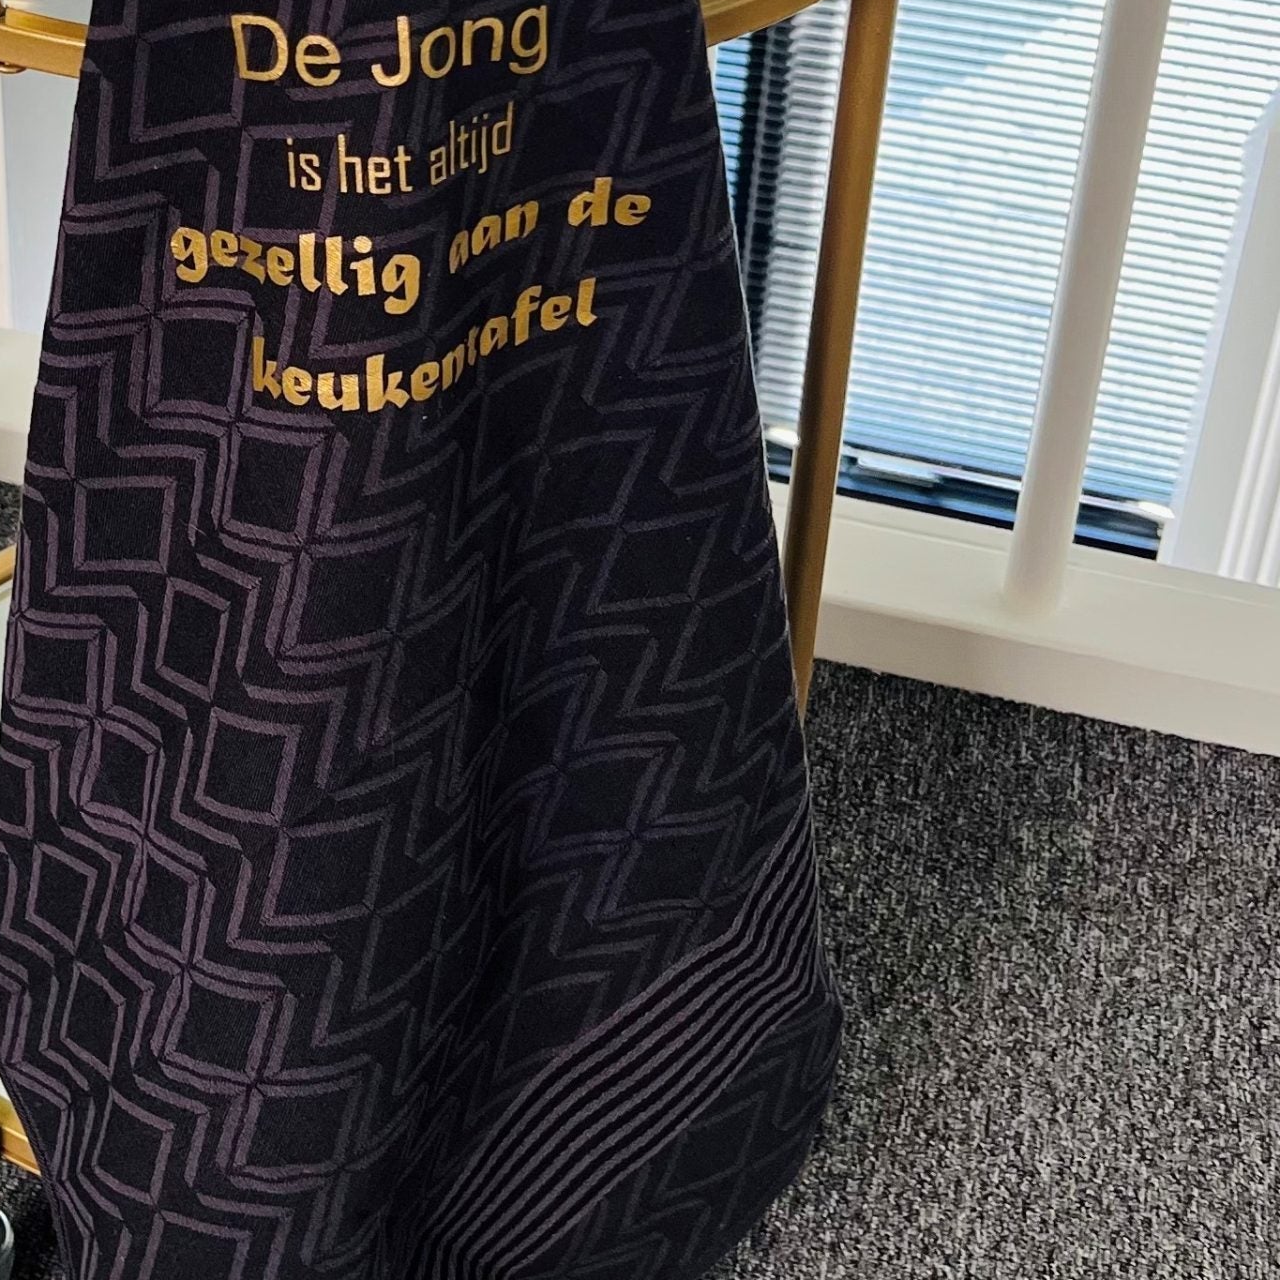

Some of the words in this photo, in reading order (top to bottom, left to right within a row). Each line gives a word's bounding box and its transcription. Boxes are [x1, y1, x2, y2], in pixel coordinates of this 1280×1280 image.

[230, 12, 342, 88] De
[371, 4, 548, 88] Jong
[286, 138, 322, 192] is
[336, 134, 412, 194] het
[429, 102, 516, 187] altijd
[169, 225, 421, 315] gezellig
[448, 200, 540, 273] aan
[567, 176, 652, 227] de
[250, 277, 598, 413] keukentafel
